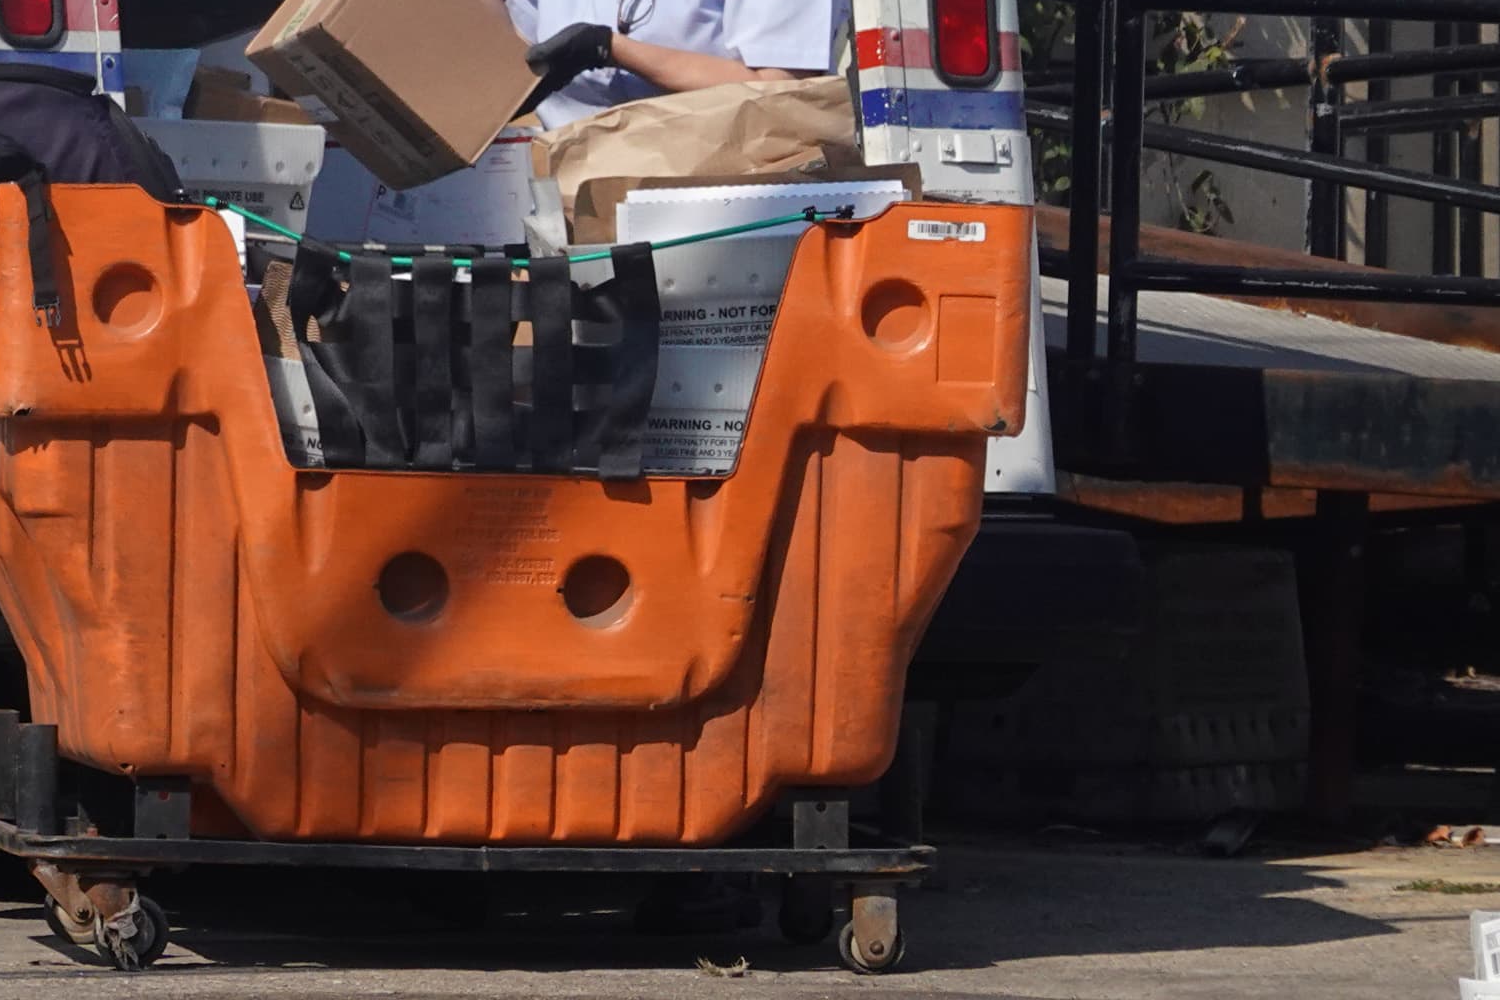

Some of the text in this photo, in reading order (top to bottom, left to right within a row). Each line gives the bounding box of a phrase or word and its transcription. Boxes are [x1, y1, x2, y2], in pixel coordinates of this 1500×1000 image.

[660, 309, 707, 322] RNING
[718, 306, 747, 319] NOT
[647, 417, 712, 431] WARNING
[724, 420, 743, 432] NO
